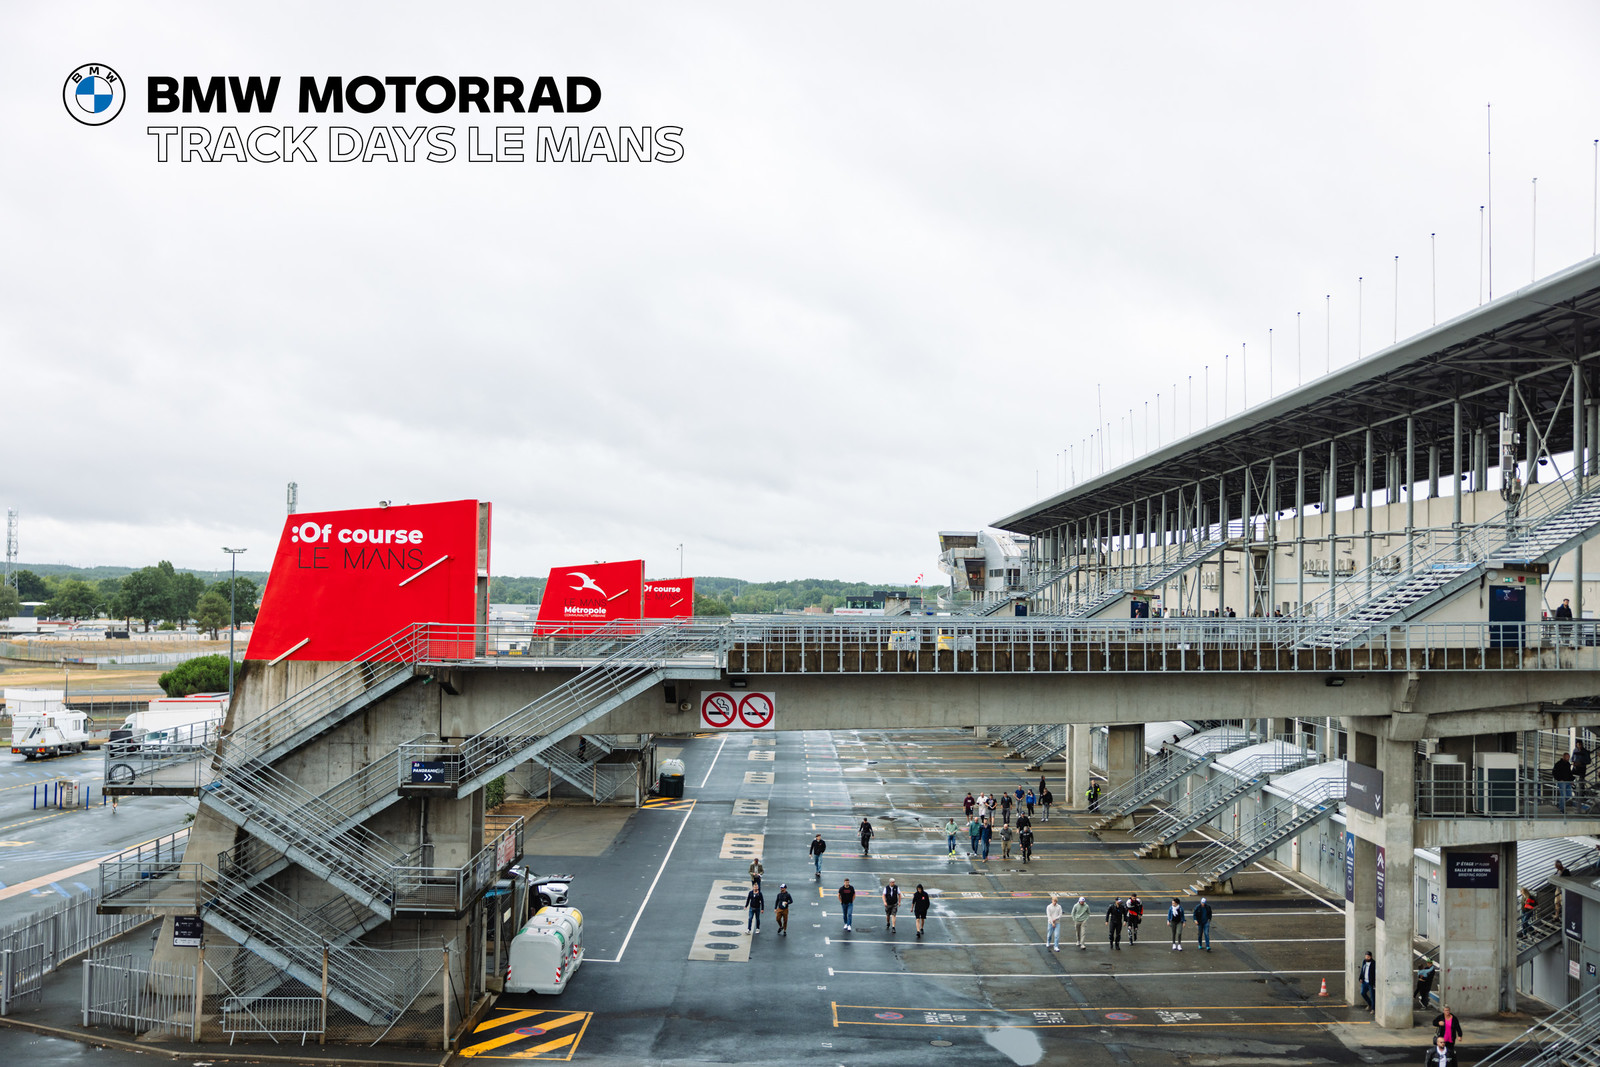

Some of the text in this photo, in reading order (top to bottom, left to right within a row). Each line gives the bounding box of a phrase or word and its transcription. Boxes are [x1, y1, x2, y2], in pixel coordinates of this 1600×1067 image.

[338, 528, 423, 544] course
[299, 547, 423, 569] LE MANS
[564, 598, 607, 607] LE MANS
[564, 606, 606, 615] Métropole
